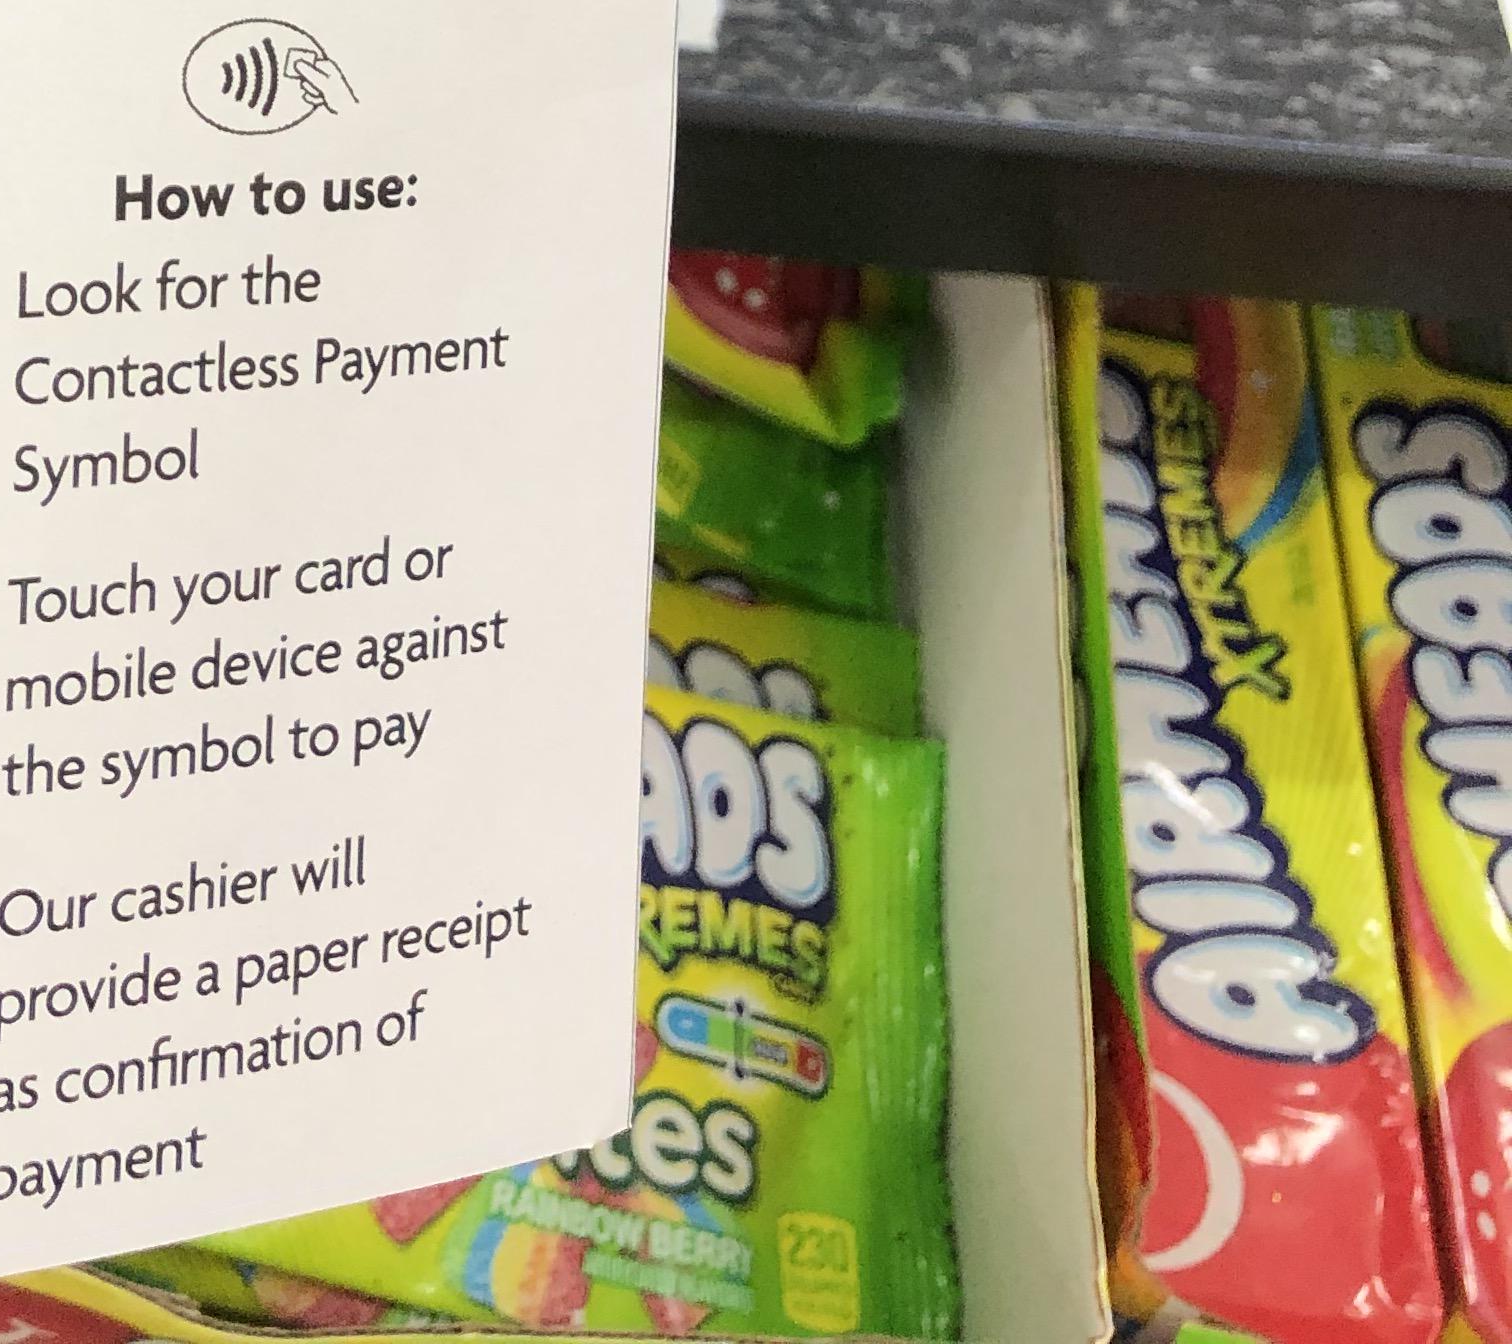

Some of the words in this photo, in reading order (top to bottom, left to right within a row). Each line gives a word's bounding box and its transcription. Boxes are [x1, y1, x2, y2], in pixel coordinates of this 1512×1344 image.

[116, 175, 234, 221] How
[250, 173, 305, 215] to
[324, 175, 417, 212] use:
[19, 263, 140, 318] Look
[156, 259, 228, 310] for
[242, 255, 320, 305] the
[16, 341, 298, 404] Contactless
[316, 328, 509, 394] Payment
[14, 428, 198, 506] Symbol
[8, 563, 155, 624] Touch
[171, 565, 281, 624] your
[296, 536, 389, 593] card
[405, 545, 453, 581] or
[7, 647, 175, 711] mobile
[192, 638, 341, 689] device
[357, 611, 508, 680] against
[1354, 410, 1512, 927] HEADS
[2, 744, 85, 796] the
[102, 715, 274, 798] symbol
[289, 720, 338, 759] to
[354, 710, 431, 766] pay
[112, 862, 277, 922] cashier
[292, 836, 365, 895] will
[197, 962, 220, 995] a
[237, 934, 368, 1005] paper
[383, 898, 531, 962] receipt
[56, 1018, 361, 1102] confirmation
[377, 989, 427, 1046] of
[492, 1179, 646, 1251] RAINBOW
